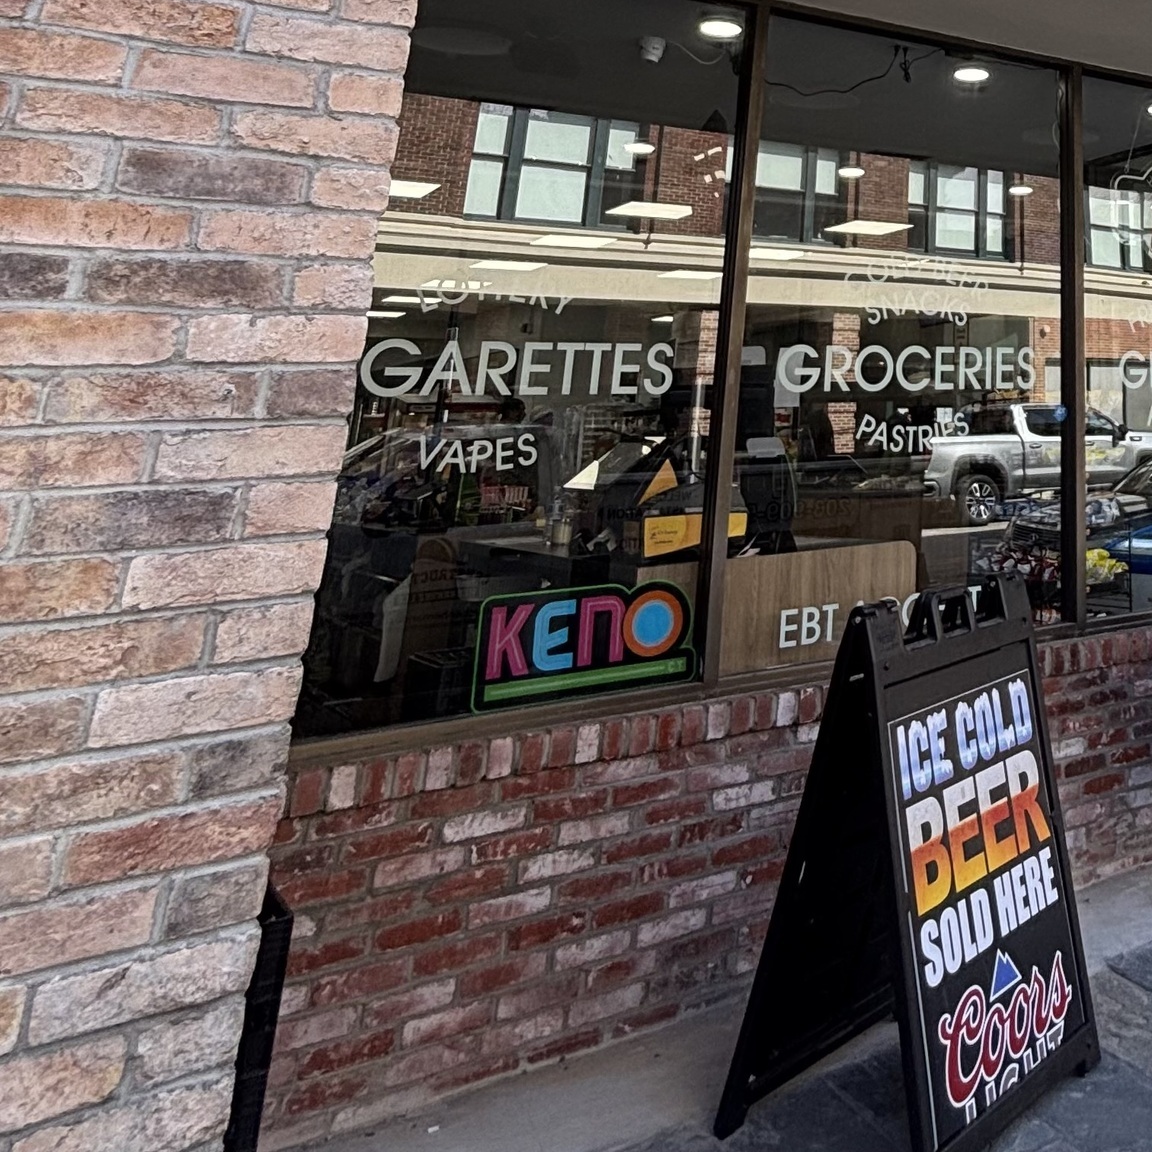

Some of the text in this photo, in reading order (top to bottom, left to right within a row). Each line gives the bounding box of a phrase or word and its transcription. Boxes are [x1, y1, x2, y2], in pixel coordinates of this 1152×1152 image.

[864, 290, 971, 326] SNACKS
[360, 339, 675, 397] GARETTES
[776, 344, 1036, 394] GROCERIES
[418, 432, 538, 473] VAPES
[855, 410, 970, 453] PASTRIES
[779, 603, 840, 648] EBT
[897, 677, 1034, 801] ICE COLD
[905, 749, 1053, 918] BEER
[919, 846, 1060, 988] SOLD HERE
[938, 950, 1074, 1108] Coors
